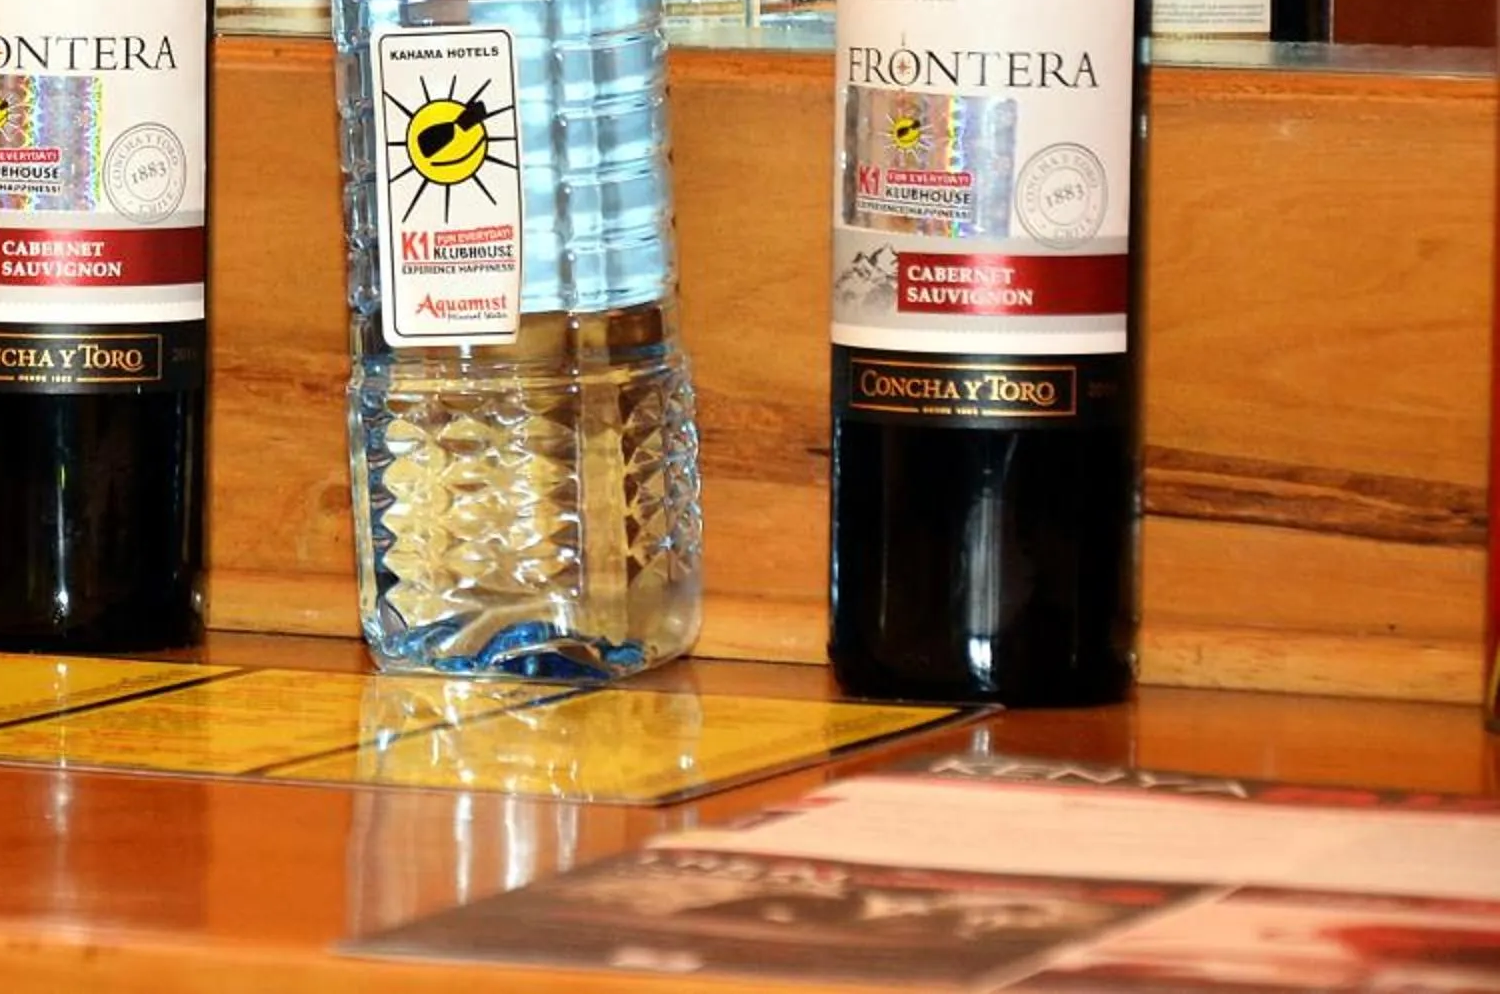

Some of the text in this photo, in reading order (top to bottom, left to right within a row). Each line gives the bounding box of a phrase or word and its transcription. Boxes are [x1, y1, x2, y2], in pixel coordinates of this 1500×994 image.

[389, 46, 499, 61] KAHAMA HOTELS
[848, 46, 1100, 88] FRONTERA
[131, 161, 167, 184] 1883
[859, 166, 880, 196] K1
[885, 186, 971, 204] KLUBHOUSE
[1046, 183, 1084, 208] 1883
[1, 240, 105, 259] CABERNET
[401, 231, 429, 260] K1
[433, 244, 514, 260] KLUBHOUSE
[1, 260, 122, 279] SAUVIGNON
[906, 265, 1015, 285] CABERNET
[416, 293, 507, 319] Aquamist
[906, 286, 1035, 307] SAUVIGNON
[57, 348, 77, 369] Y
[76, 343, 145, 372] TORO
[860, 369, 961, 400] CONCHA
[963, 379, 984, 401] Y
[982, 374, 1060, 406] TORO
